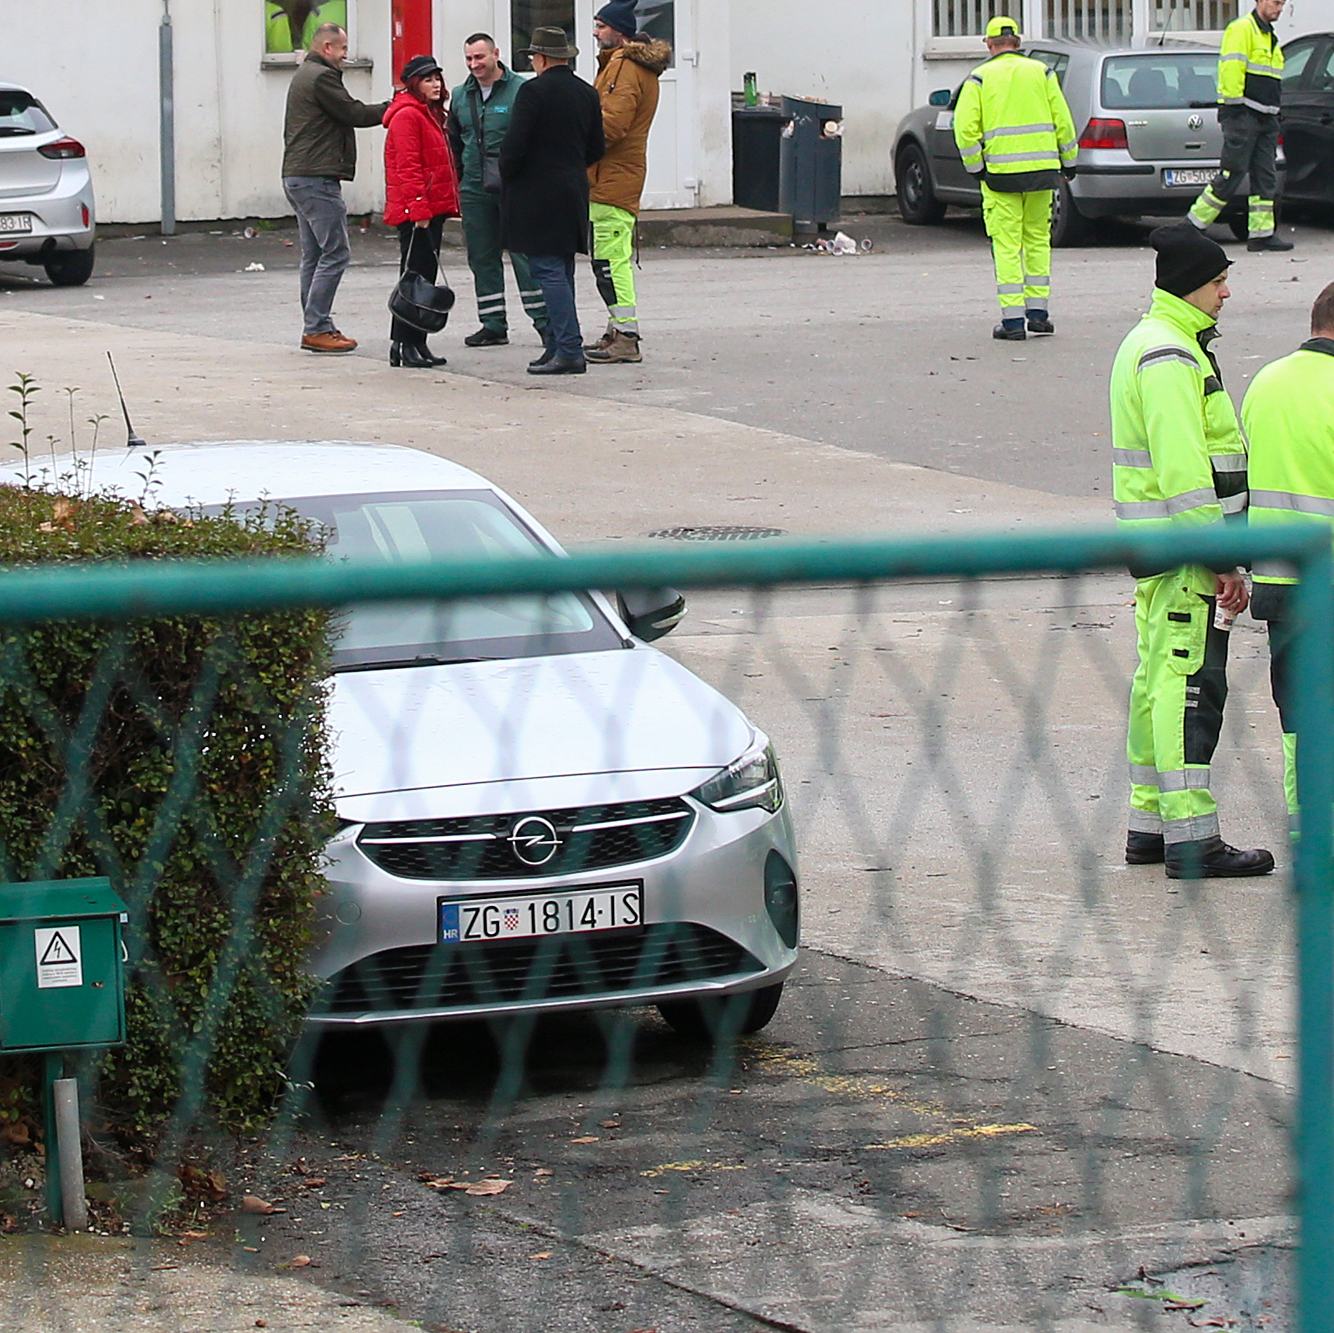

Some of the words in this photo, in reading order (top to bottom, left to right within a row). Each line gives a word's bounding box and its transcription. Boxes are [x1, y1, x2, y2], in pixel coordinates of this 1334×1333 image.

[1173, 170, 1187, 183] ZG
[463, 905, 500, 939] ZG
[443, 929, 458, 940] HR
